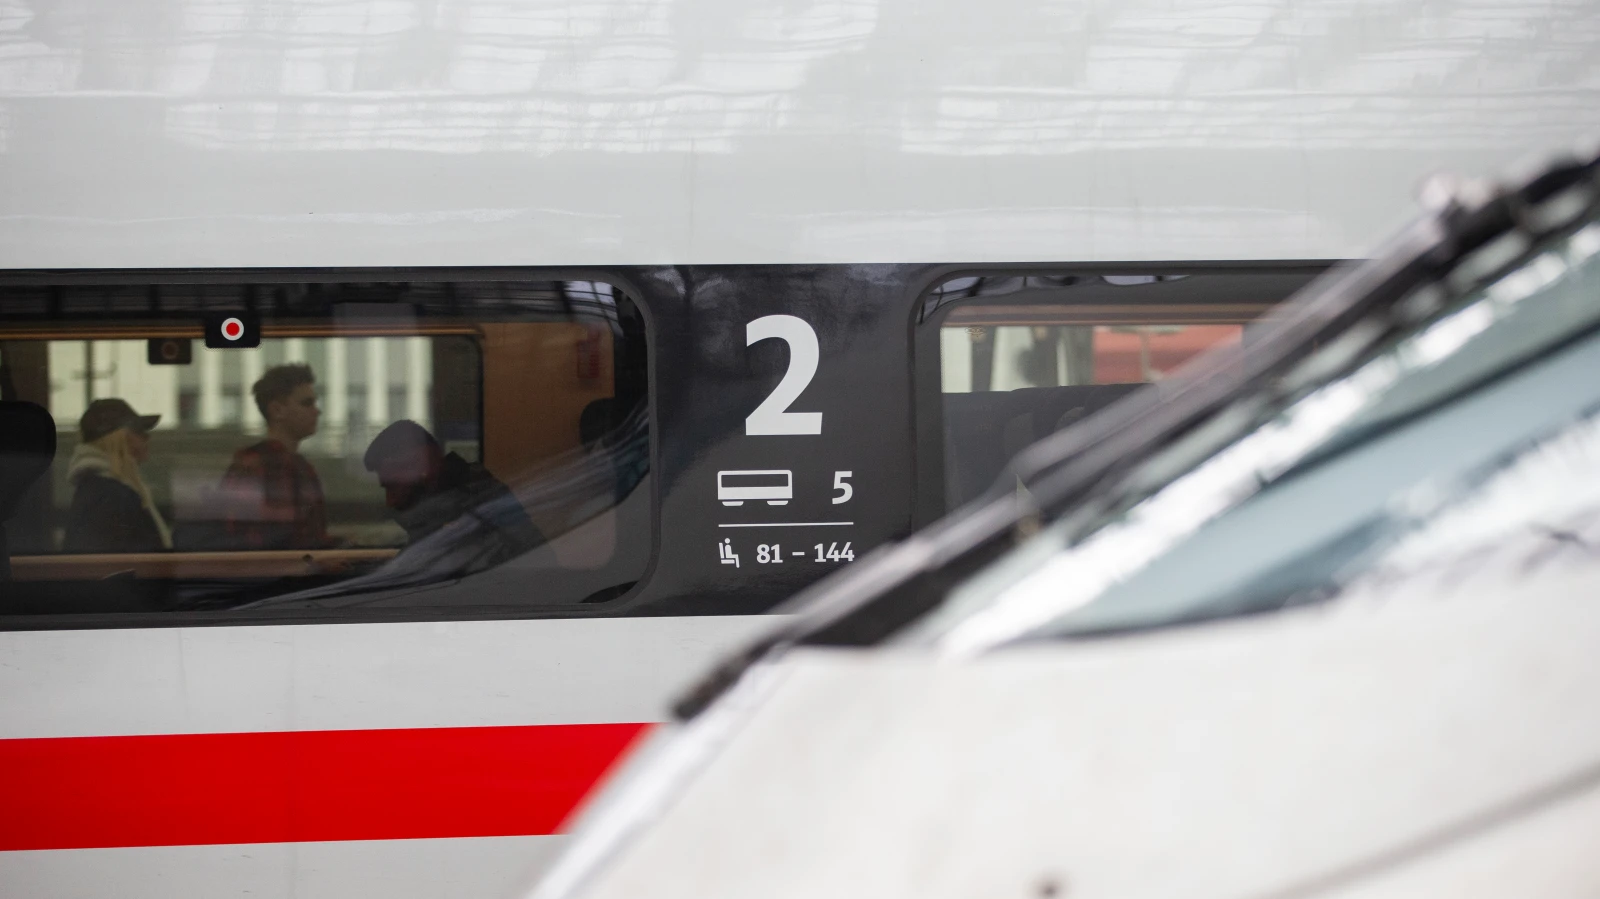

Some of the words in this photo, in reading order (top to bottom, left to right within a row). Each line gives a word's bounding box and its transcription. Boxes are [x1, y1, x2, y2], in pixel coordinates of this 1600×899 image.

[745, 314, 823, 436] 2
[831, 470, 853, 505] 5
[756, 543, 784, 564] 81
[814, 541, 855, 563] 144
